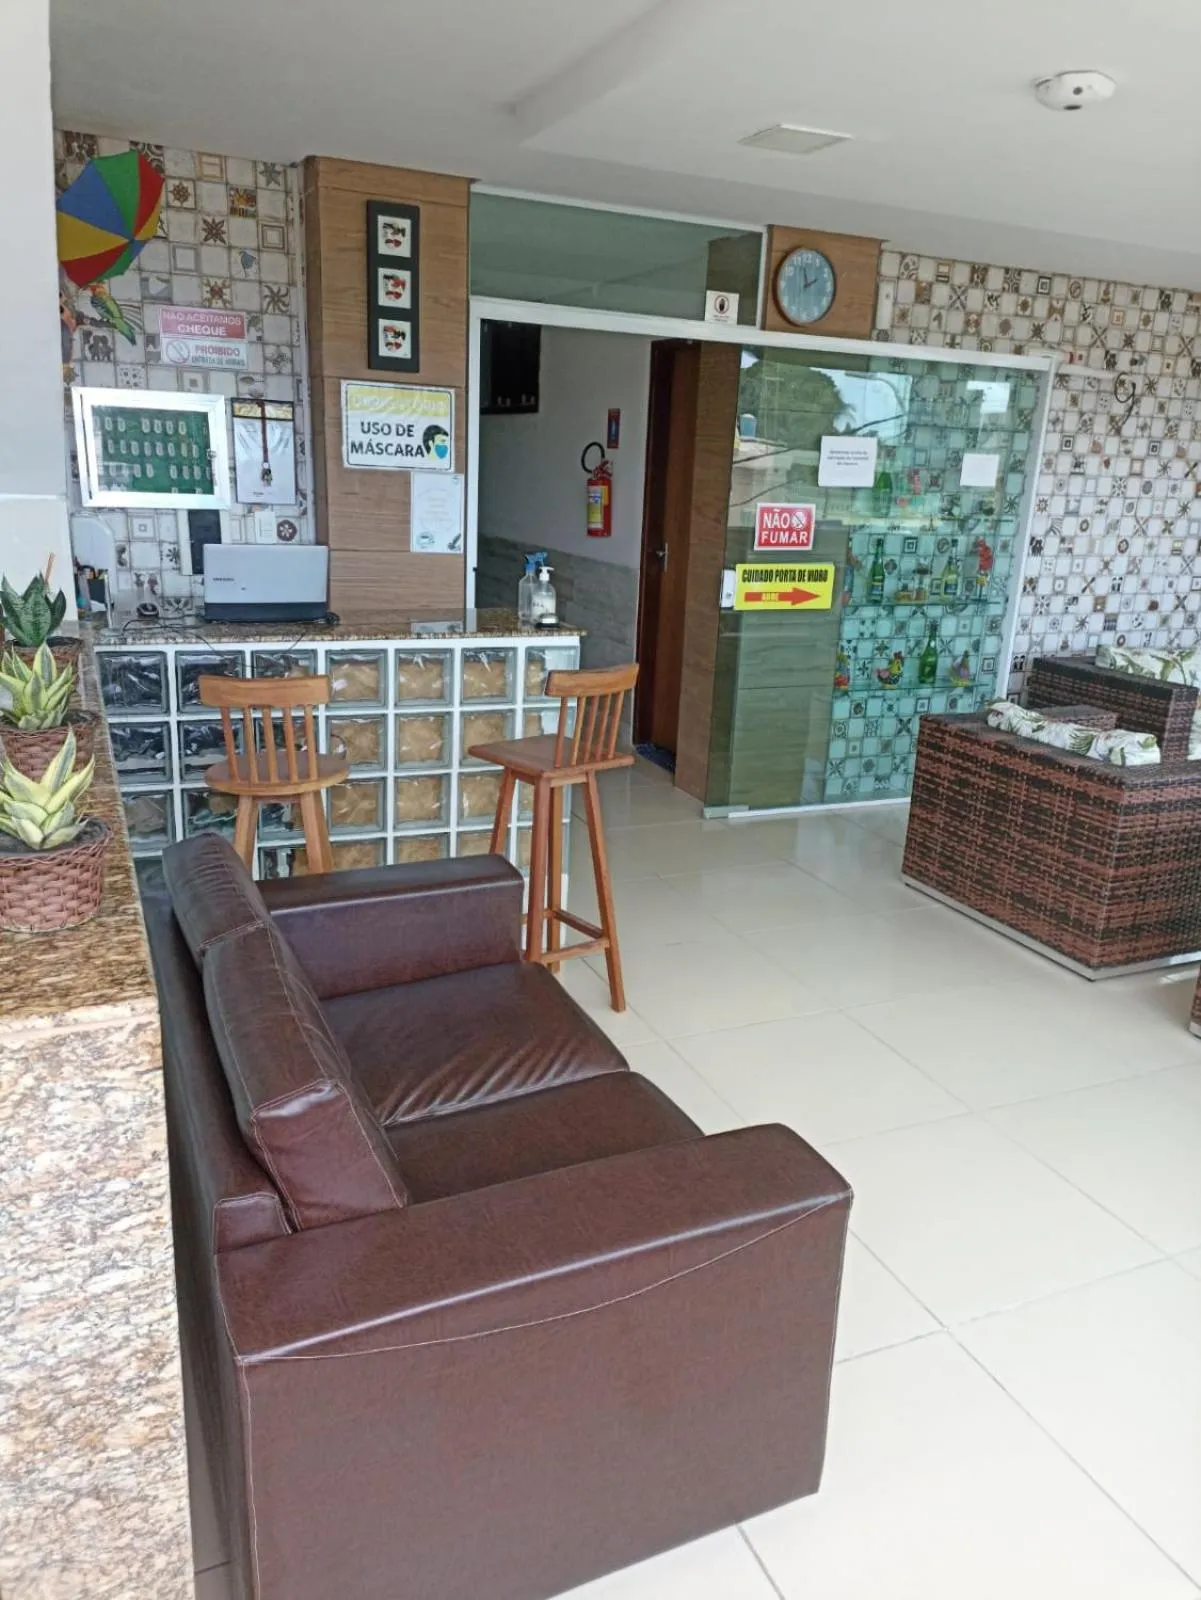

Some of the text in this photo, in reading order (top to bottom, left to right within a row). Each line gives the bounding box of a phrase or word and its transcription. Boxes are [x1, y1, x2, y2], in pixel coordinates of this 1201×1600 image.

[177, 324, 228, 336] CHEQUE
[195, 344, 241, 357] PROIBIDO
[360, 421, 415, 438] USO DE
[350, 438, 425, 458] MÁSCARA
[762, 508, 790, 529] NÃO
[761, 530, 808, 544] FUMAR
[742, 568, 829, 583] CUIDADO PORTA DE VIDRO
